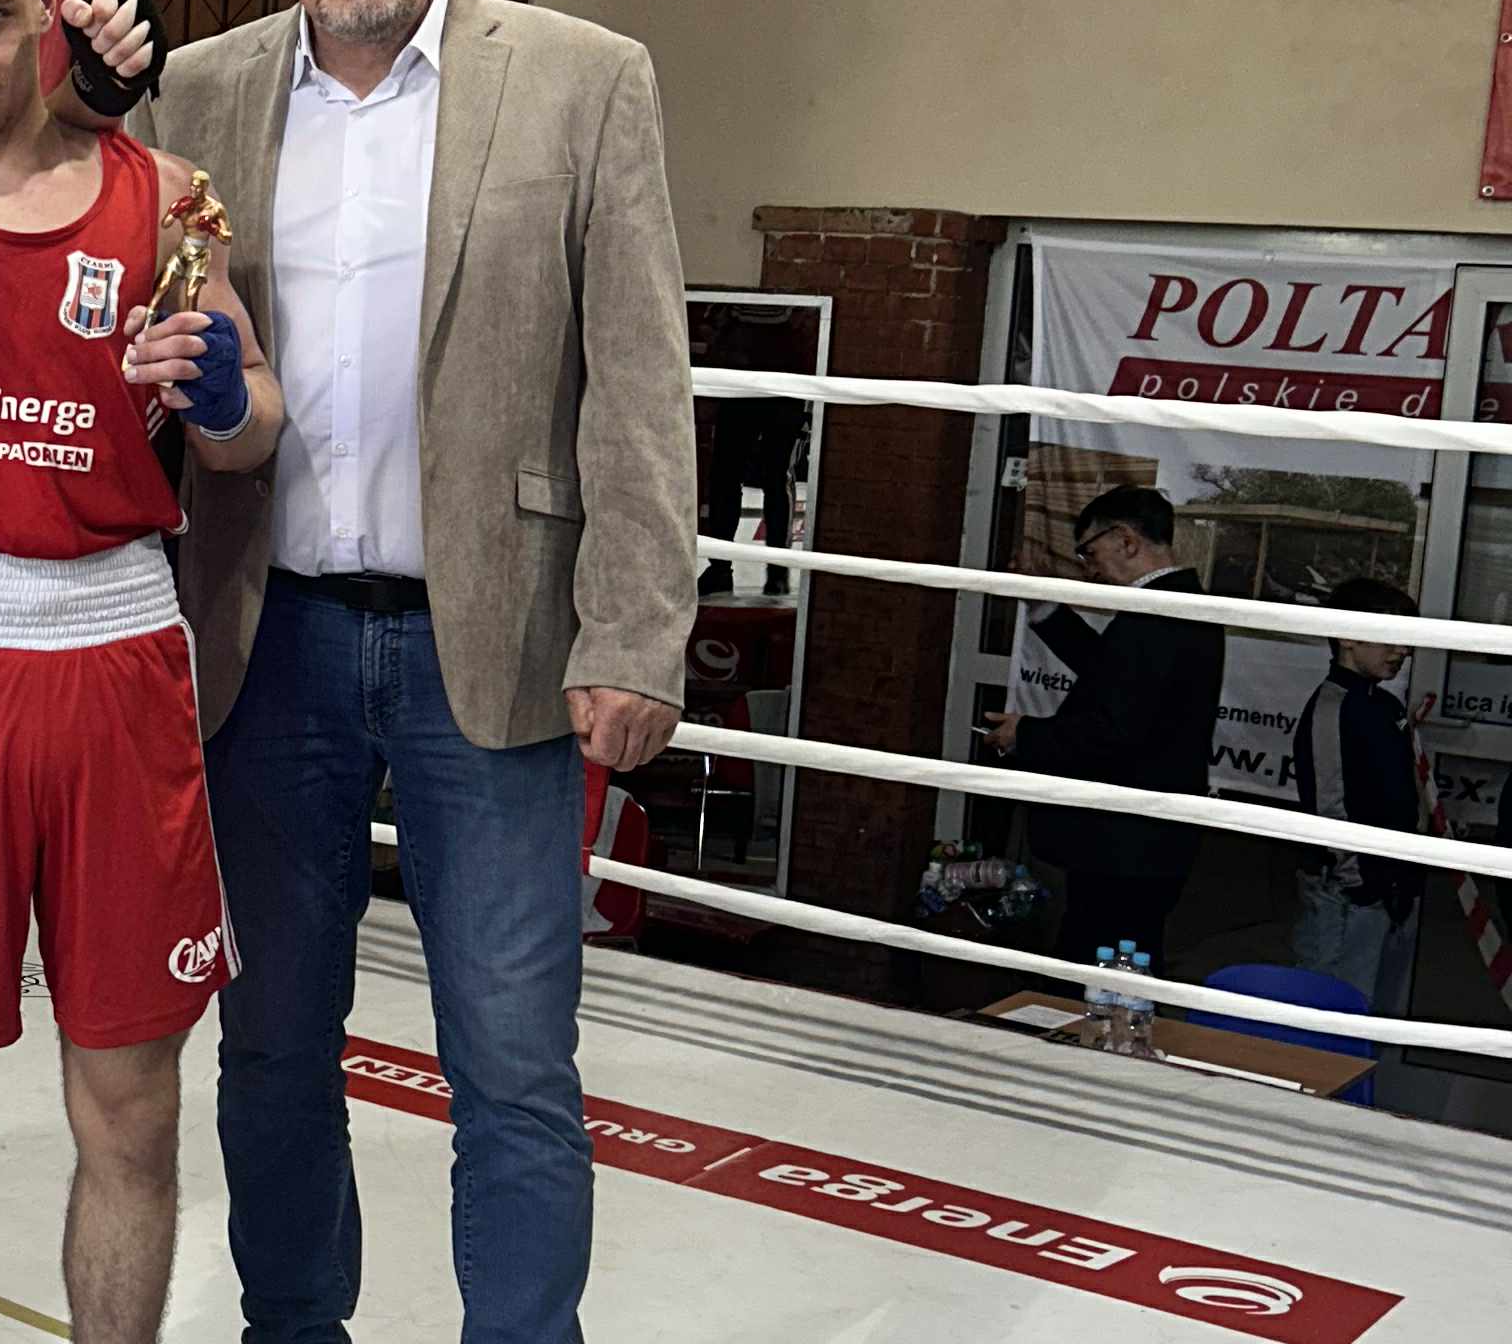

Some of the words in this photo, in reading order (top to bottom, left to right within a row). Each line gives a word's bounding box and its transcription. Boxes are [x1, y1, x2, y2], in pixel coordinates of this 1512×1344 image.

[1127, 273, 1453, 360] POLTA
[1139, 371, 1358, 413] polskie
[27, 444, 89, 468] ORLEN
[1216, 706, 1297, 734] ementy
[347, 1059, 454, 1093] LEN
[580, 1116, 697, 1154] GRU
[758, 1163, 1138, 1271] Energa
